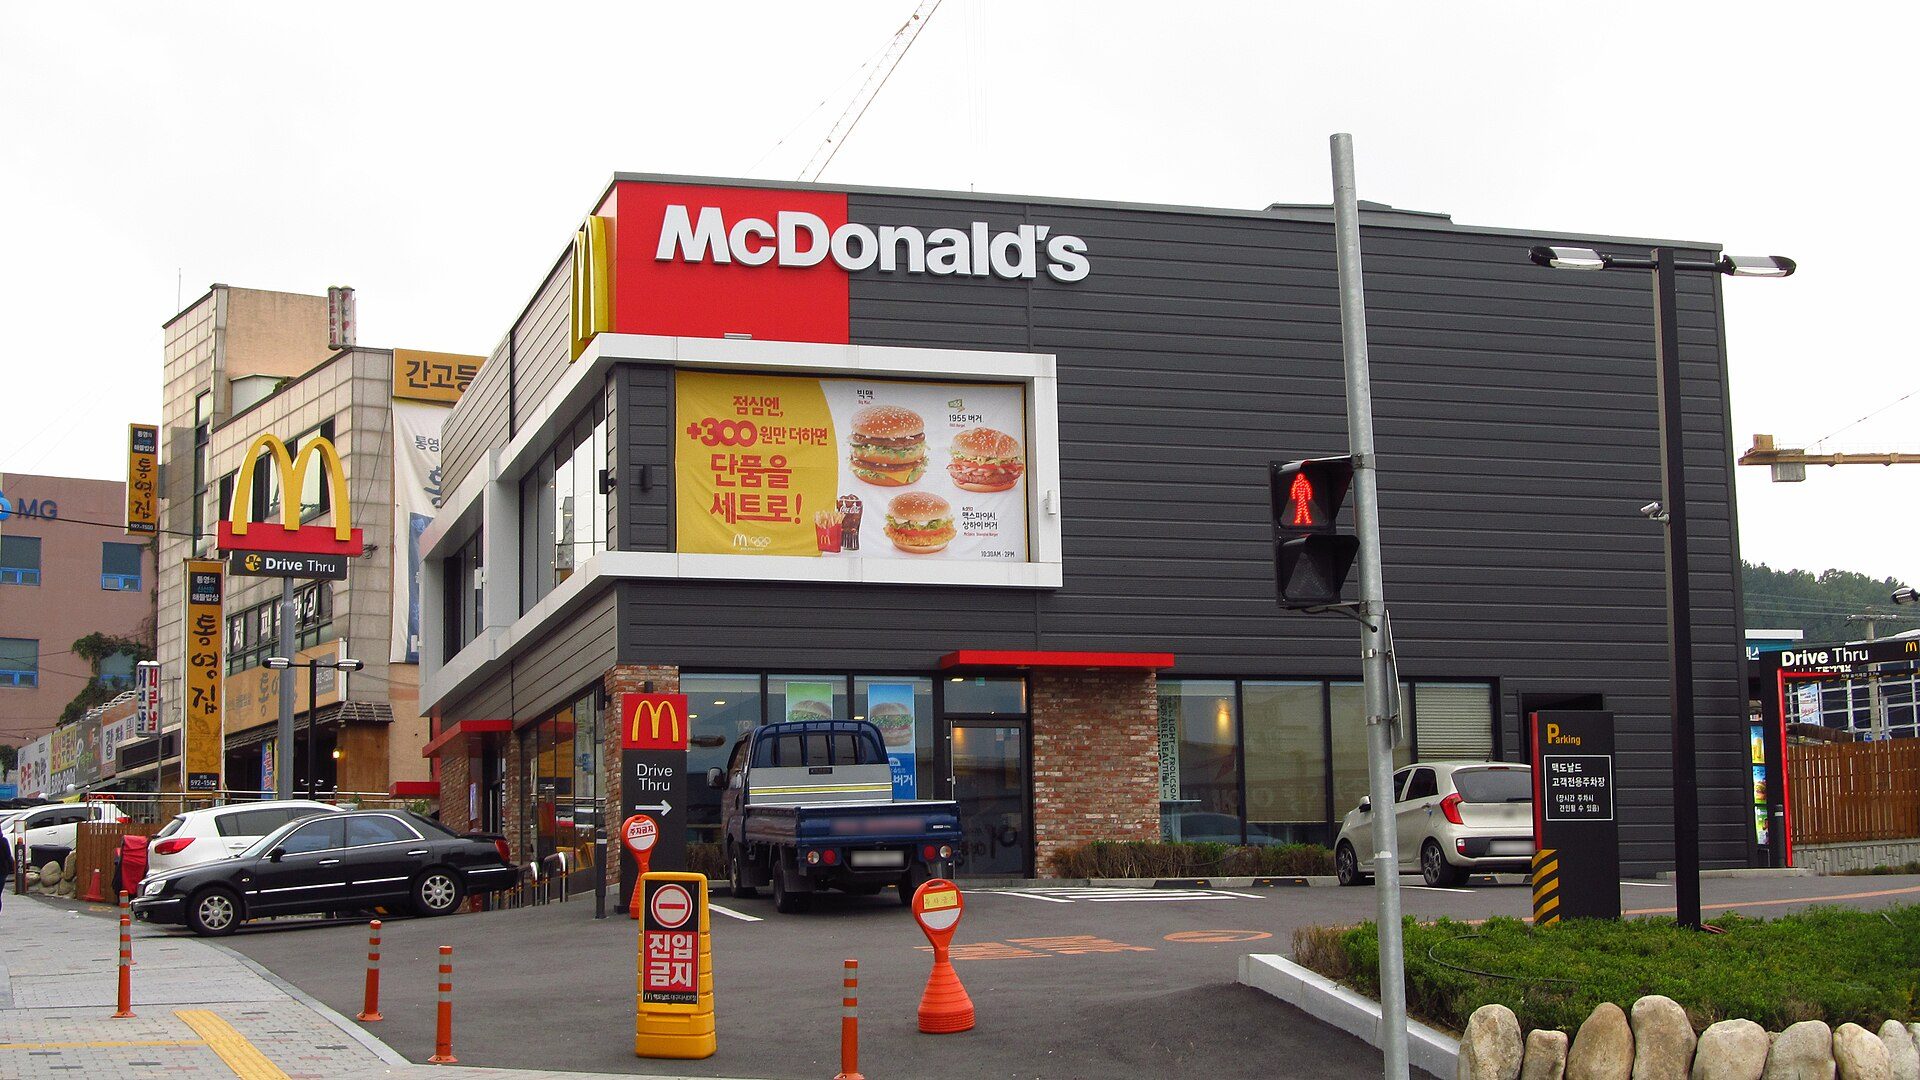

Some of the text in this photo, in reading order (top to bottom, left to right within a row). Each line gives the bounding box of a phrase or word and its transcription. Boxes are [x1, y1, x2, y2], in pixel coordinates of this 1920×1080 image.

[655, 204, 1092, 283] McDonald's
[857, 389, 874, 399] 빅맥
[733, 396, 784, 417] 점심엔,
[949, 414, 982, 423] 1955 버거
[415, 435, 439, 453] 통영
[789, 427, 828, 446] 더하면
[711, 453, 792, 489] 단품을
[18, 498, 57, 521] MG
[709, 492, 803, 525] 세트로!
[962, 512, 996, 520] 맥스파이시
[963, 521, 998, 530] 상하이 버거
[265, 557, 336, 573] Drive Thru
[1781, 647, 1869, 667] Drive Thru
[1547, 723, 1581, 746] Parking
[636, 763, 673, 777] Drive
[1551, 762, 1583, 773] 맥도날드
[638, 777, 671, 792] Thru
[1551, 776, 1606, 788] 고객전용주차장
[1555, 794, 1594, 803] (장시간 주차시
[1578, 804, 1584, 812] 수
[649, 934, 693, 959] 진입
[650, 961, 693, 988] 금지
